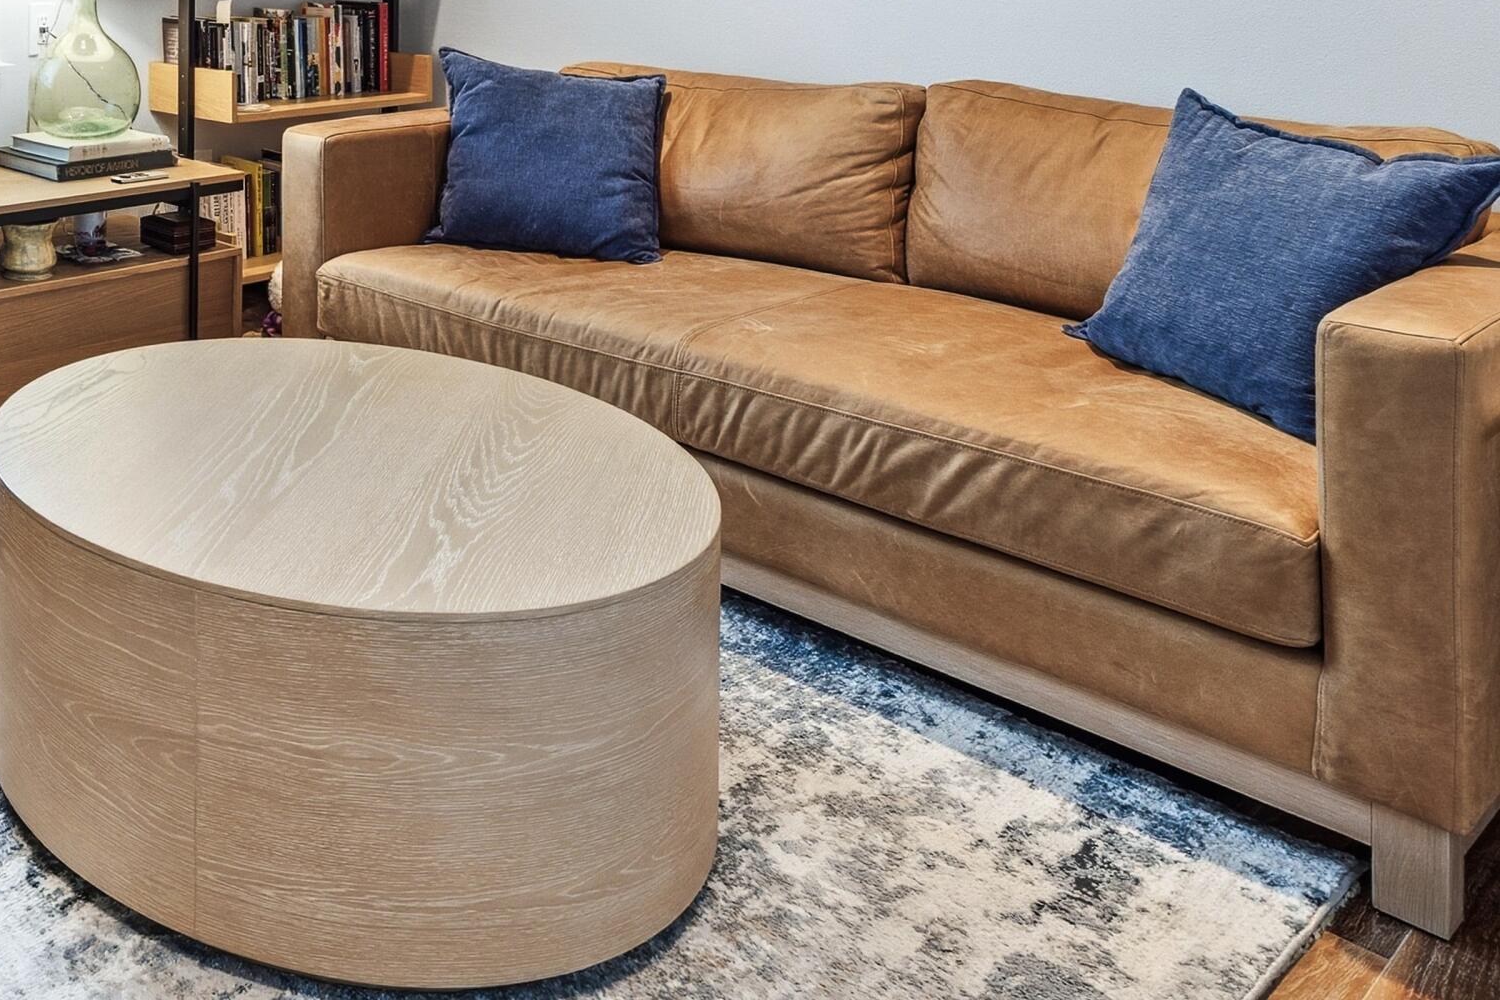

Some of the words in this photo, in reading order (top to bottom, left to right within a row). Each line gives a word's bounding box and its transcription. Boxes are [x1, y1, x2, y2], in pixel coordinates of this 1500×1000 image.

[64, 163, 94, 178] HISTORY
[94, 163, 106, 175] OF
[105, 158, 140, 173] AVIATION
